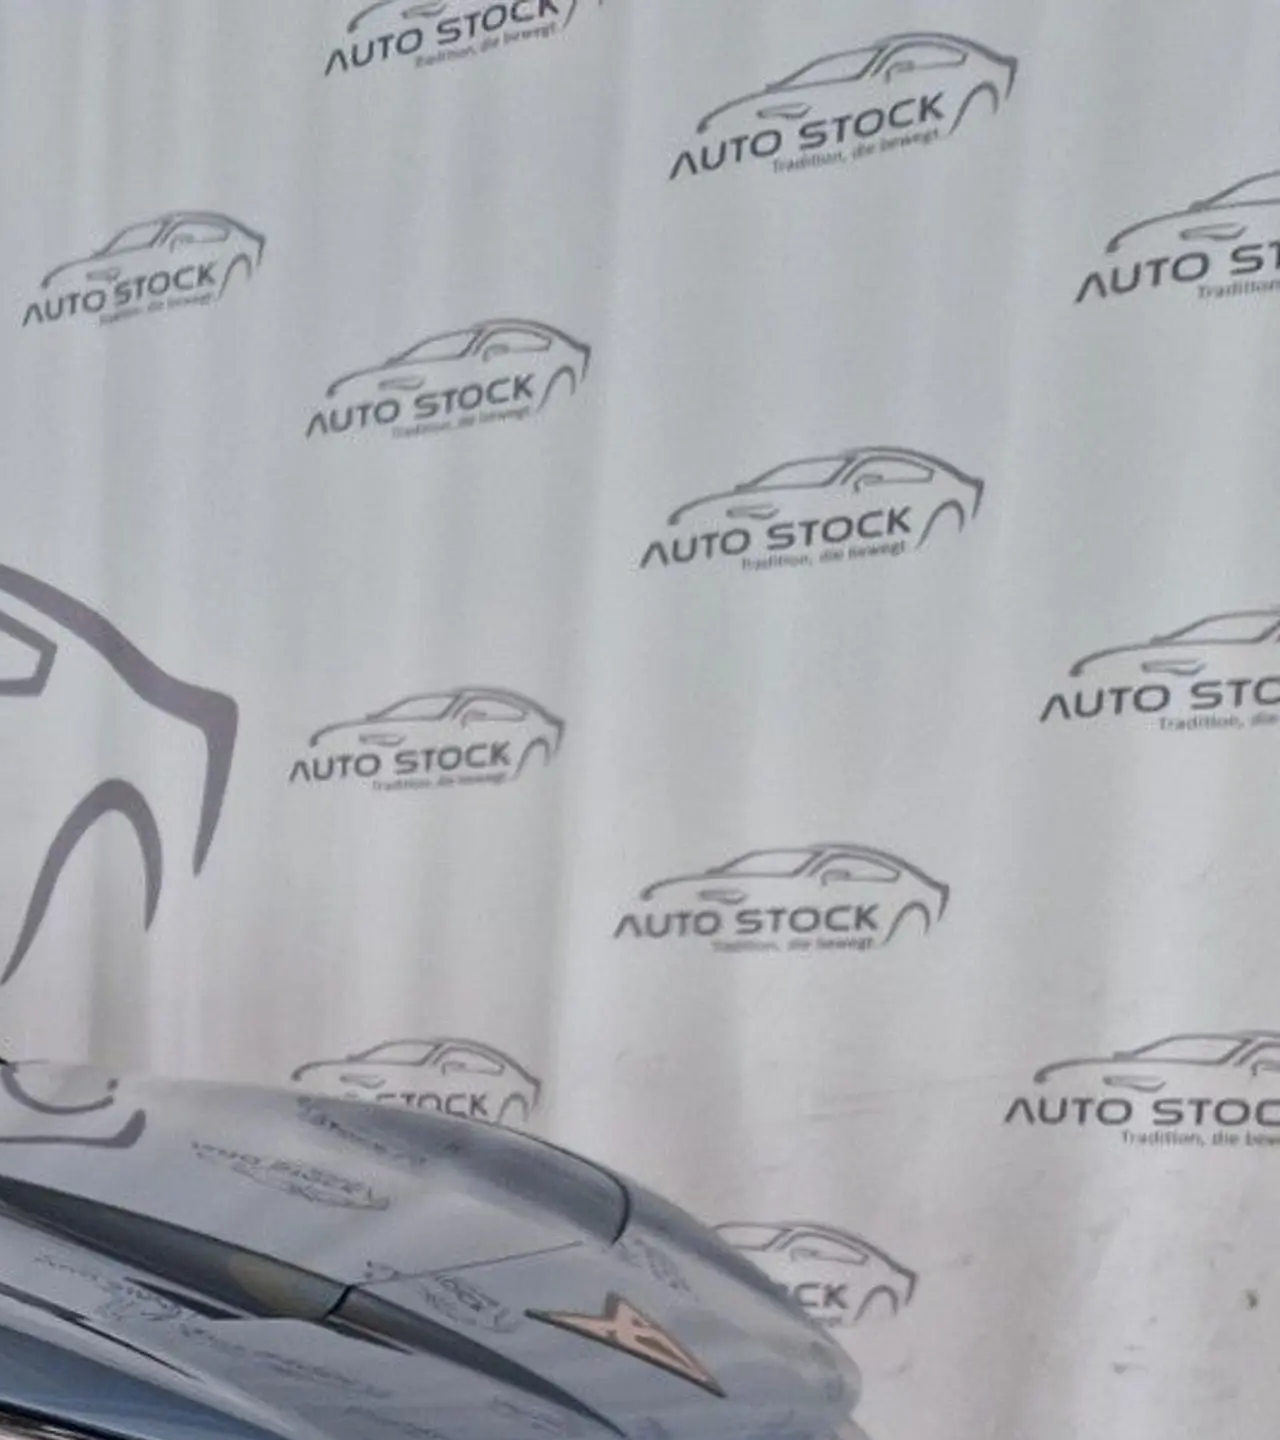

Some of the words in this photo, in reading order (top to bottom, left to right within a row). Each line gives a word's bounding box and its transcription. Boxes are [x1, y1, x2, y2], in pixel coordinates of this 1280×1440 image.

[325, 28, 422, 76] AUTO
[669, 129, 781, 180] AUTO
[798, 92, 944, 150] STOCK
[22, 289, 106, 327] AUTO
[114, 260, 217, 307] STOCK
[1075, 252, 1210, 304] AUTO
[306, 398, 400, 439] AUTO
[413, 373, 534, 420] STOCK
[640, 528, 751, 569] AUTO
[767, 505, 911, 550] STOCK
[1039, 685, 1171, 723] AUTO
[289, 753, 381, 782] AUTO
[394, 740, 510, 775] STOCK
[613, 910, 722, 939] AUTO
[735, 903, 878, 935] STOCK
[1004, 1096, 1133, 1125] AUTO
